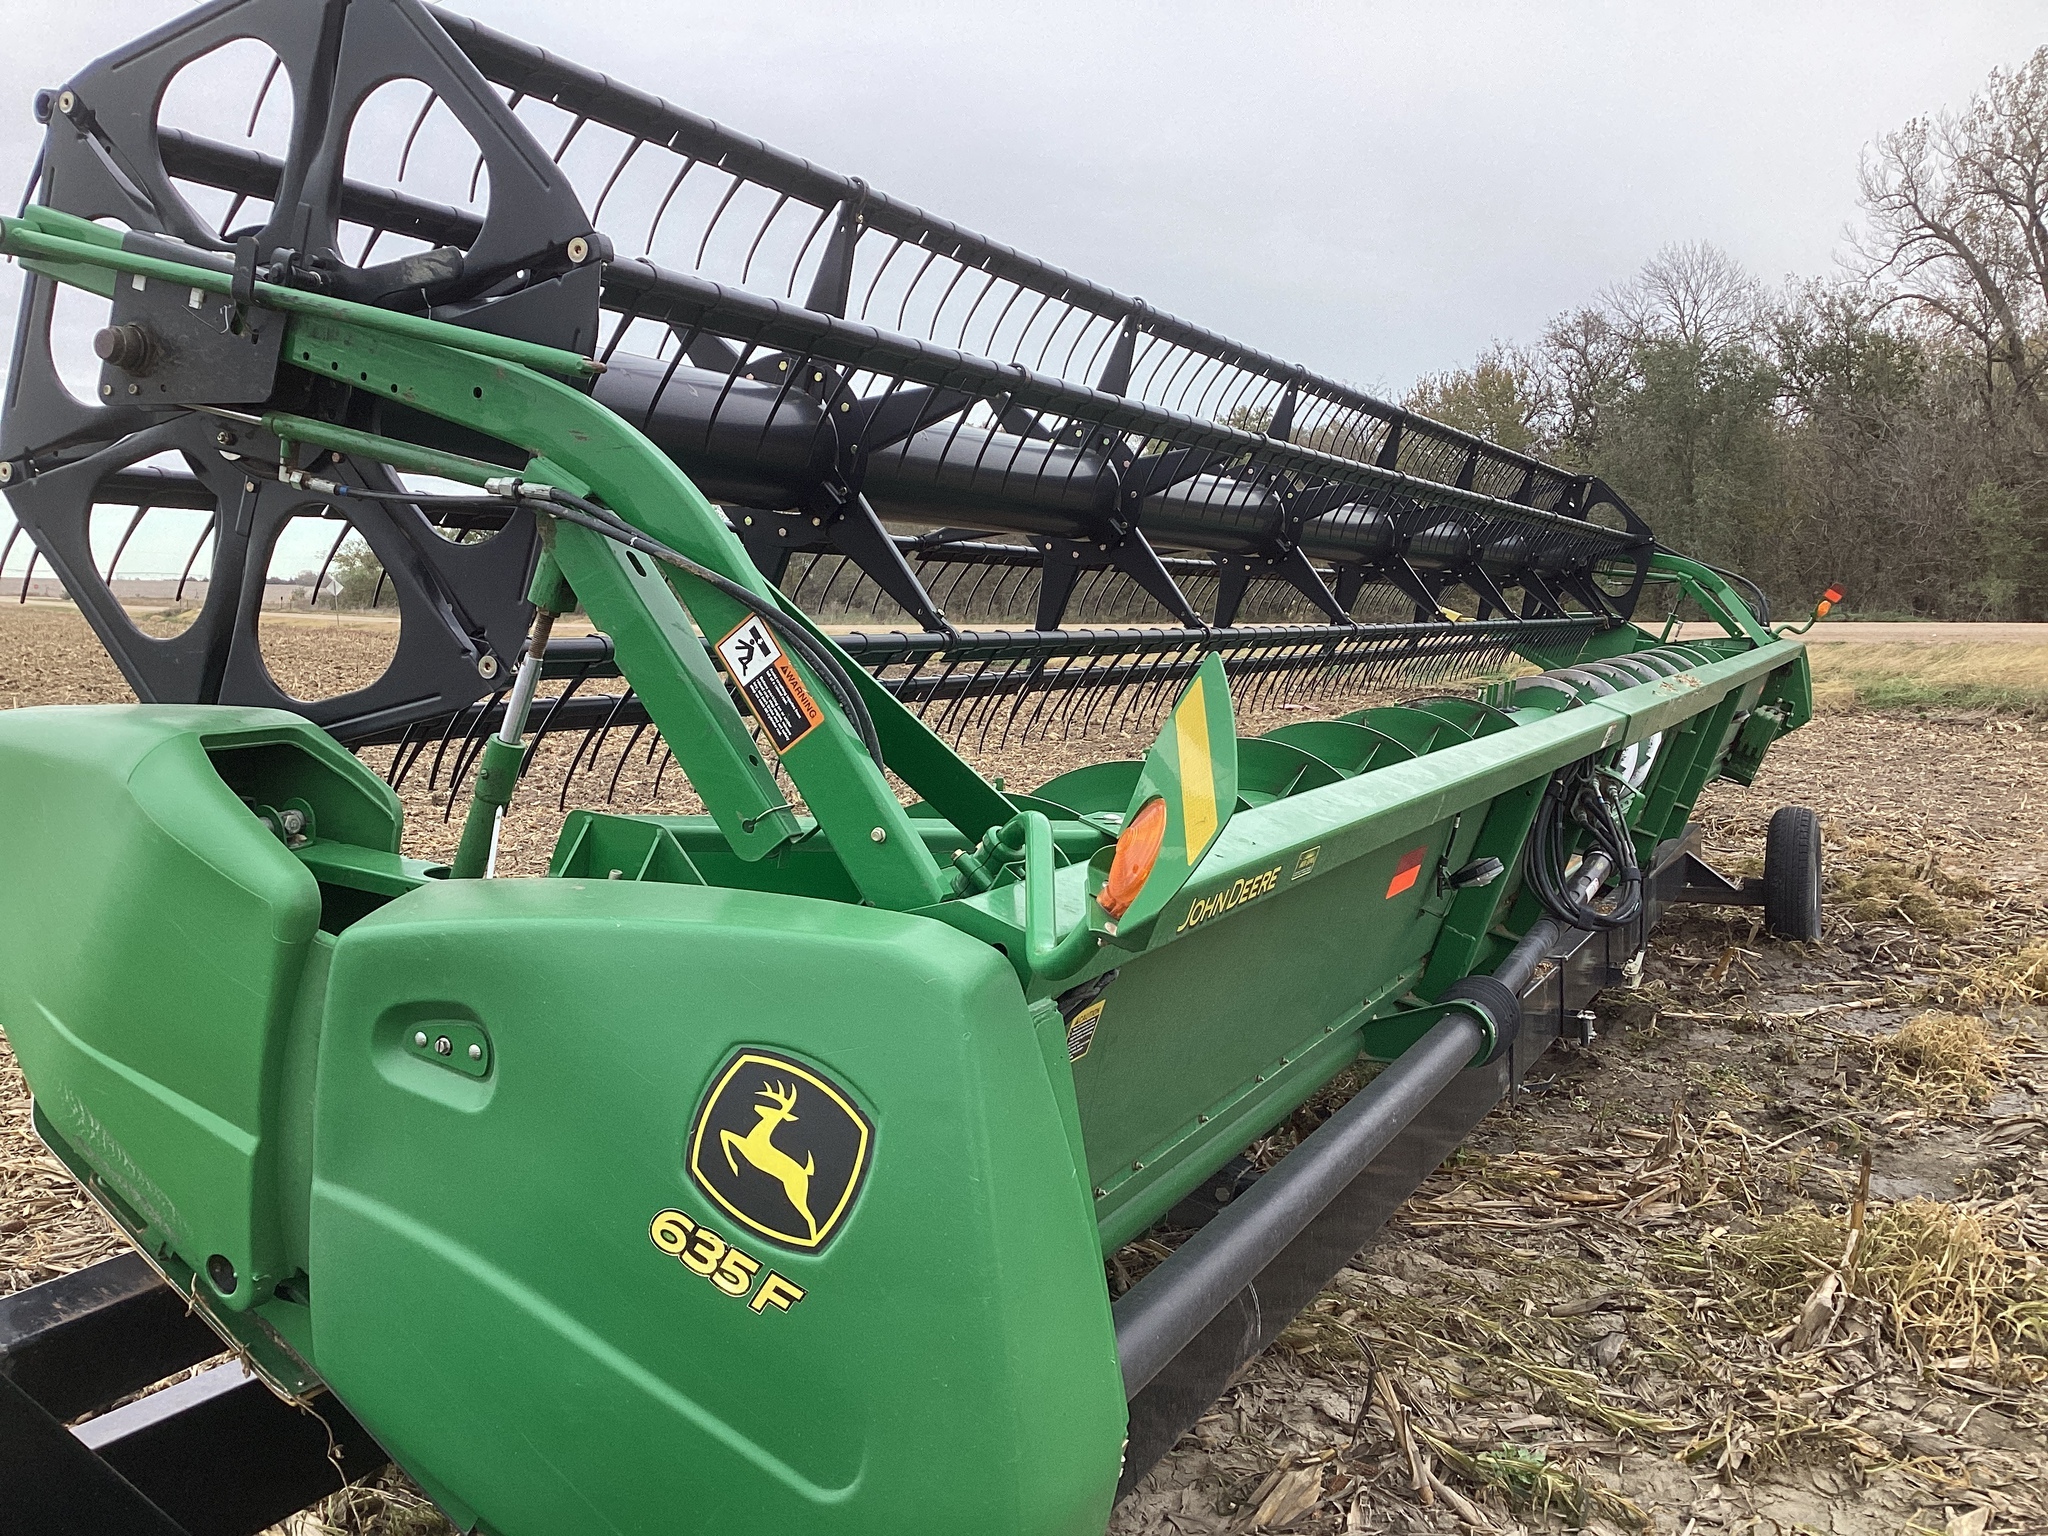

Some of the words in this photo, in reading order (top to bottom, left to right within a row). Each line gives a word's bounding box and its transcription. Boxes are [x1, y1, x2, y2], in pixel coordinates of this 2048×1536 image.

[785, 670, 817, 719] WARNING
[1176, 888, 1230, 932] JOHN
[1227, 866, 1282, 911] DEERE
